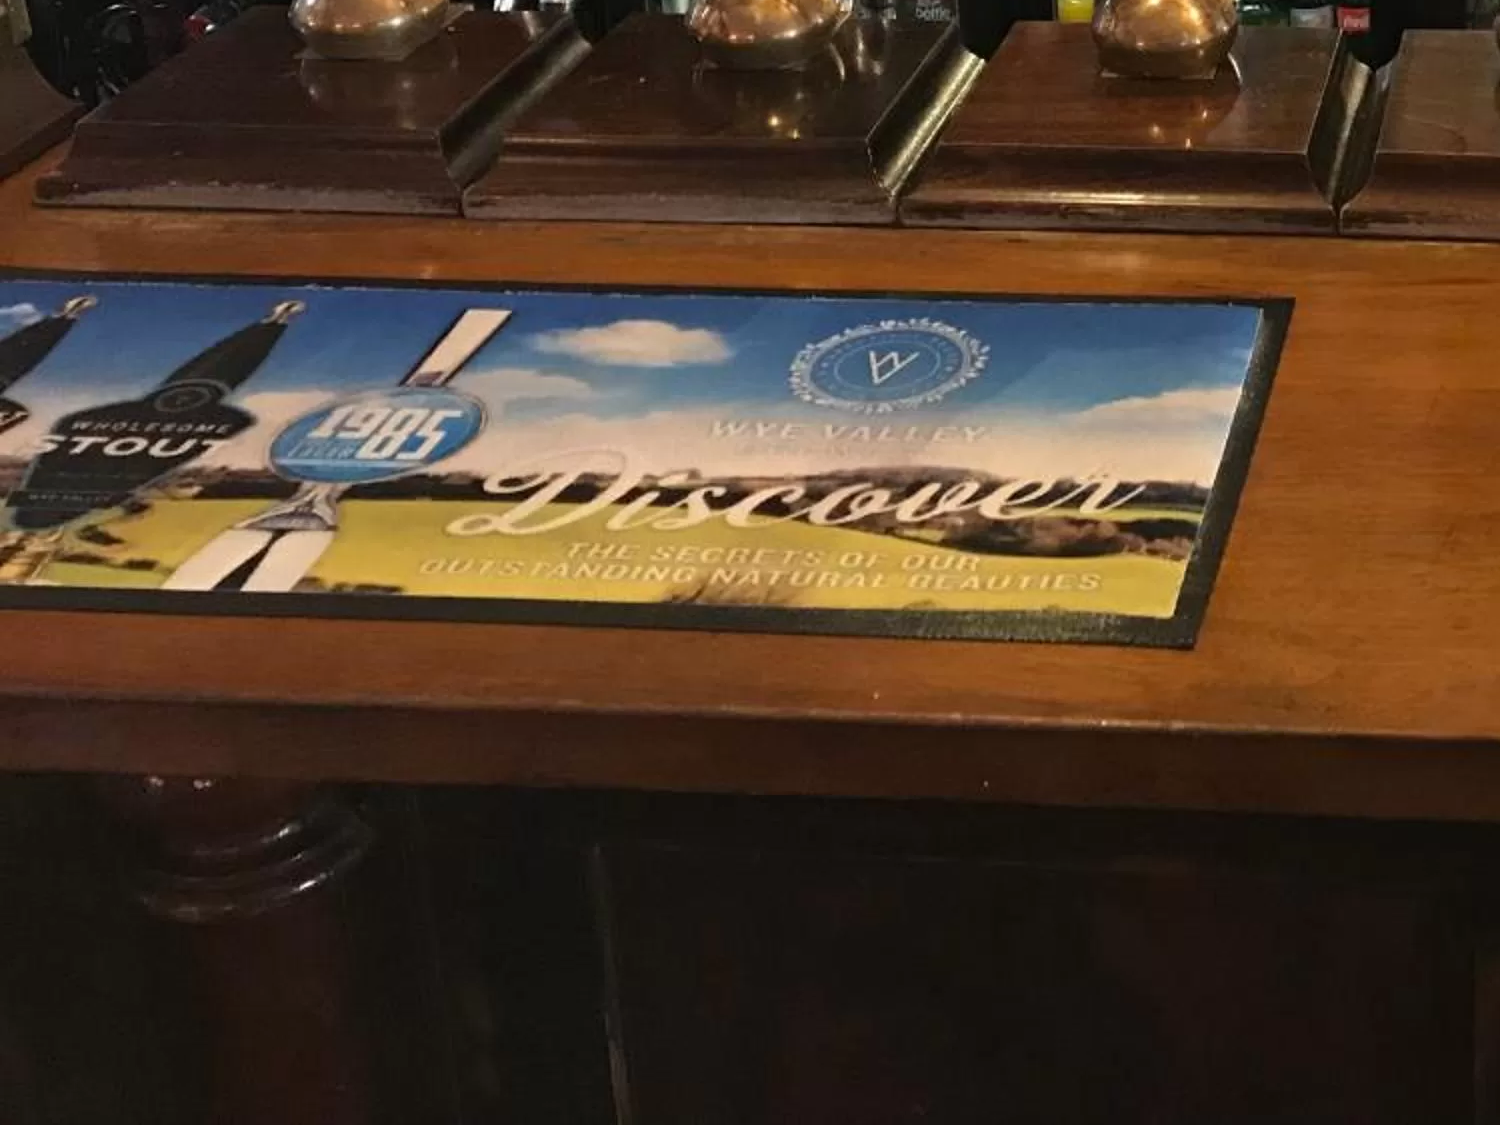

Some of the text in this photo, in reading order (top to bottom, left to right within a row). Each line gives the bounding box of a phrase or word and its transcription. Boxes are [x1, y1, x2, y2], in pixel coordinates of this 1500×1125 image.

[70, 421, 230, 434] WHOLESOME
[307, 406, 463, 460] 1985
[711, 420, 986, 443] WYE VALLEY
[30, 434, 234, 458] STOUT
[445, 448, 1146, 536] Discover
[567, 542, 981, 572] THE SECRETS OF OUR
[419, 558, 1103, 591] OUTSTANDING NATURAL BEAUTIES
